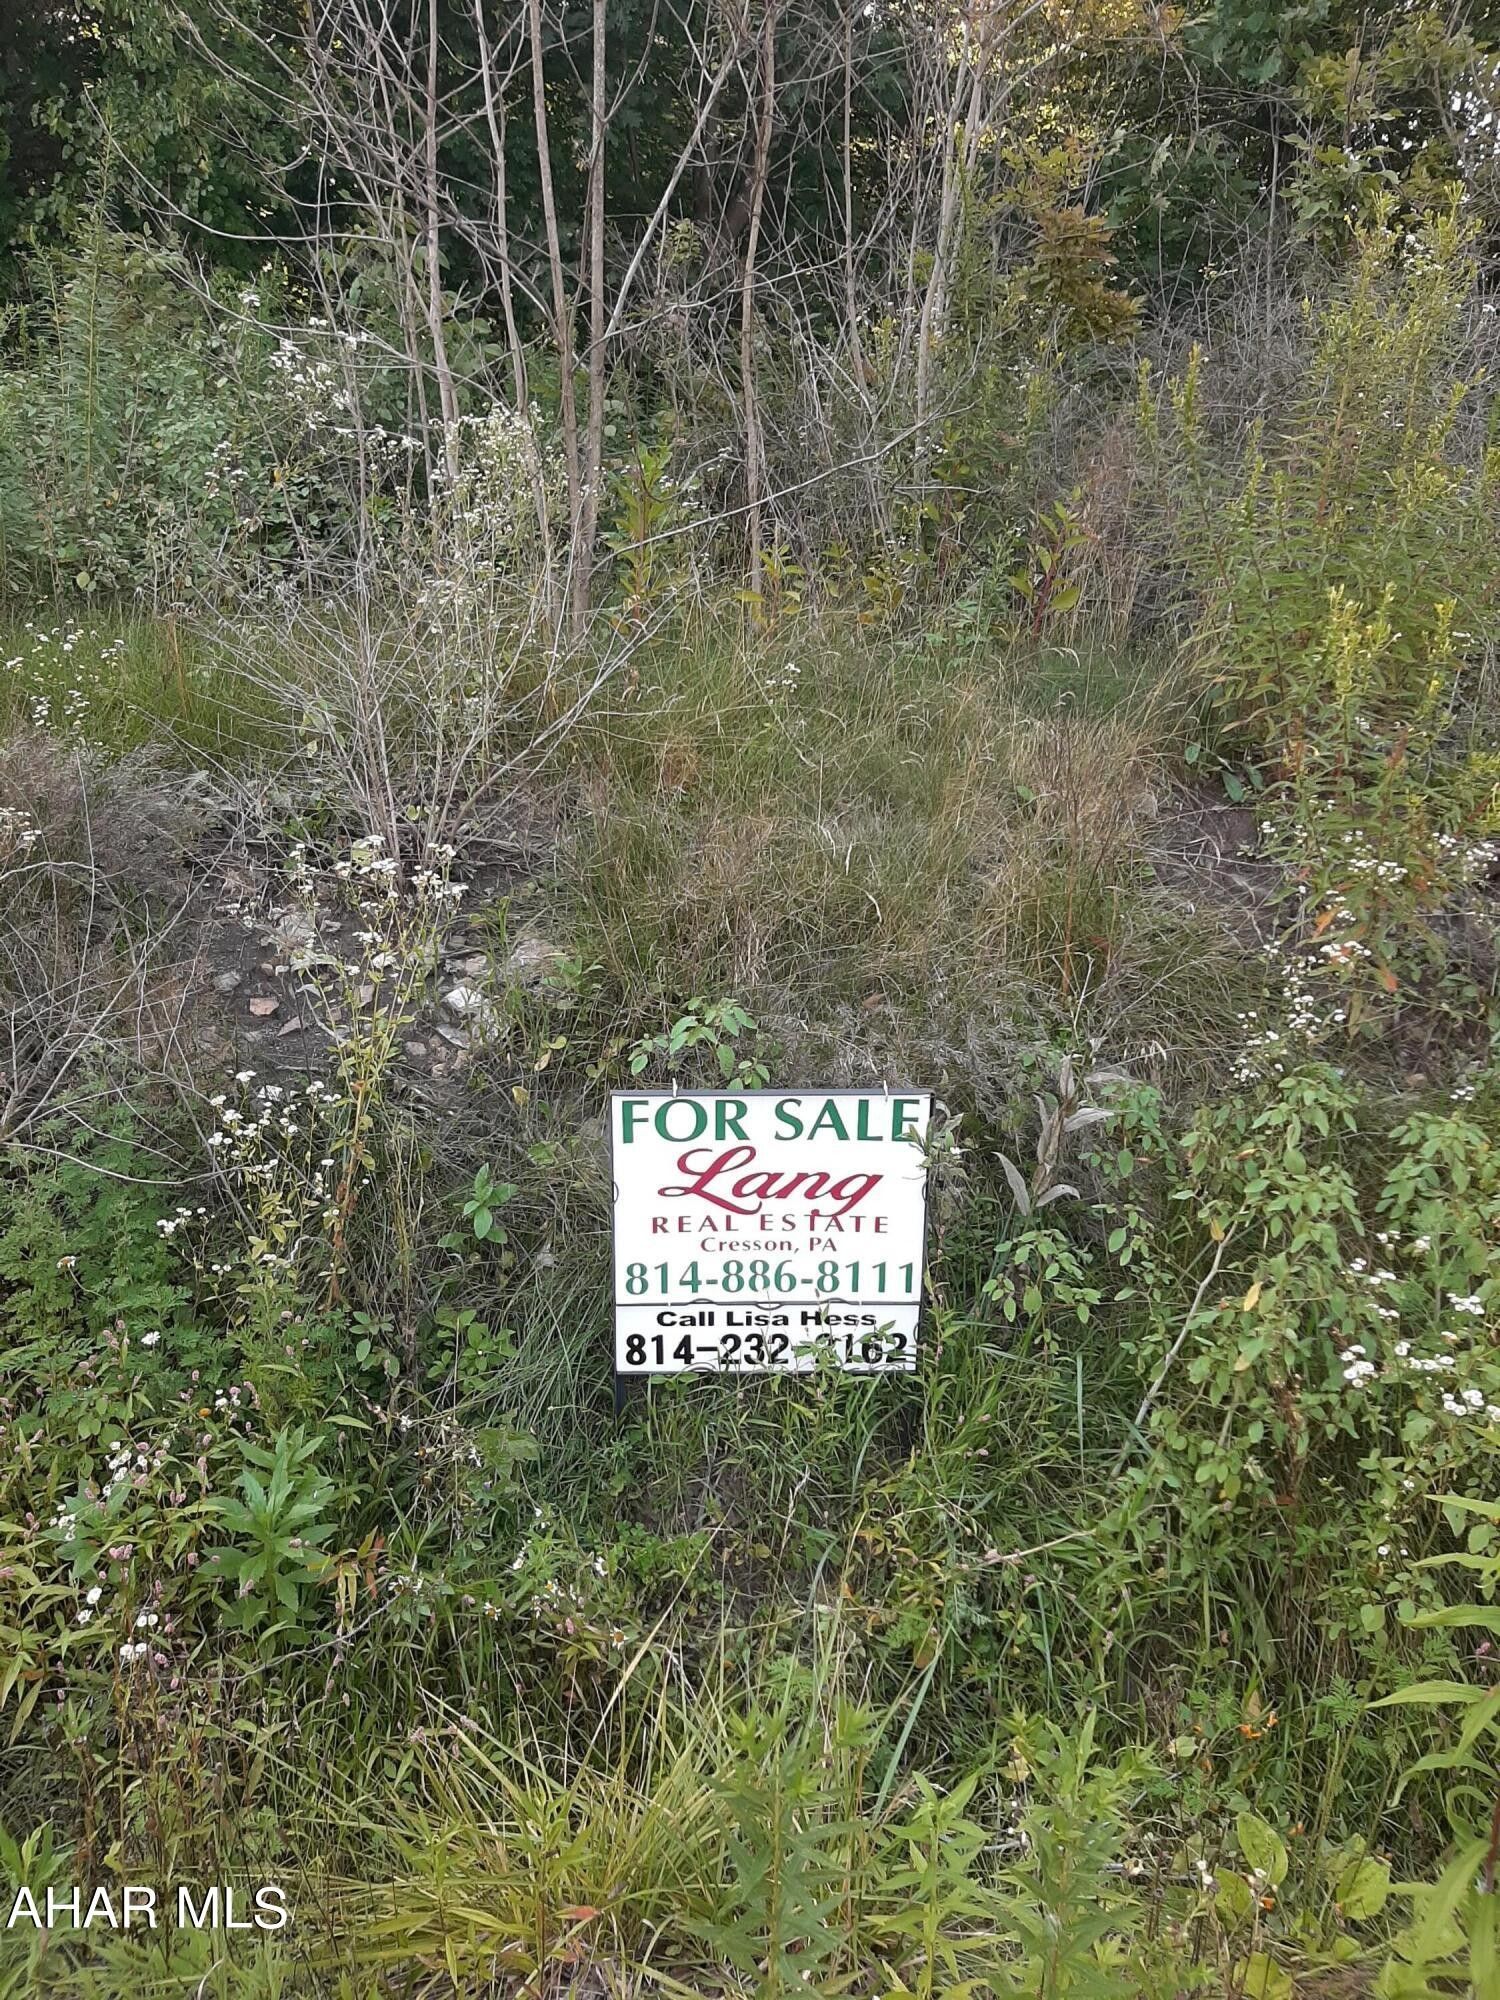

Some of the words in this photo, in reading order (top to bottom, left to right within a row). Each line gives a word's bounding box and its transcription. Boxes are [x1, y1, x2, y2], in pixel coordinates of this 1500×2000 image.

[621, 1098, 750, 1144] FOR
[774, 1098, 921, 1143] SALE
[657, 1145, 884, 1216] Lang
[651, 1215, 739, 1234] REAL
[759, 1213, 889, 1234] ESTATE
[700, 1236, 799, 1253] Cresson,
[809, 1237, 837, 1252] PA
[625, 1259, 914, 1295] 814-886-8111
[656, 1311, 715, 1327] Call
[726, 1311, 789, 1327] Lisa
[800, 1311, 877, 1327] Hess
[625, 1333, 907, 1365] 814-232162
